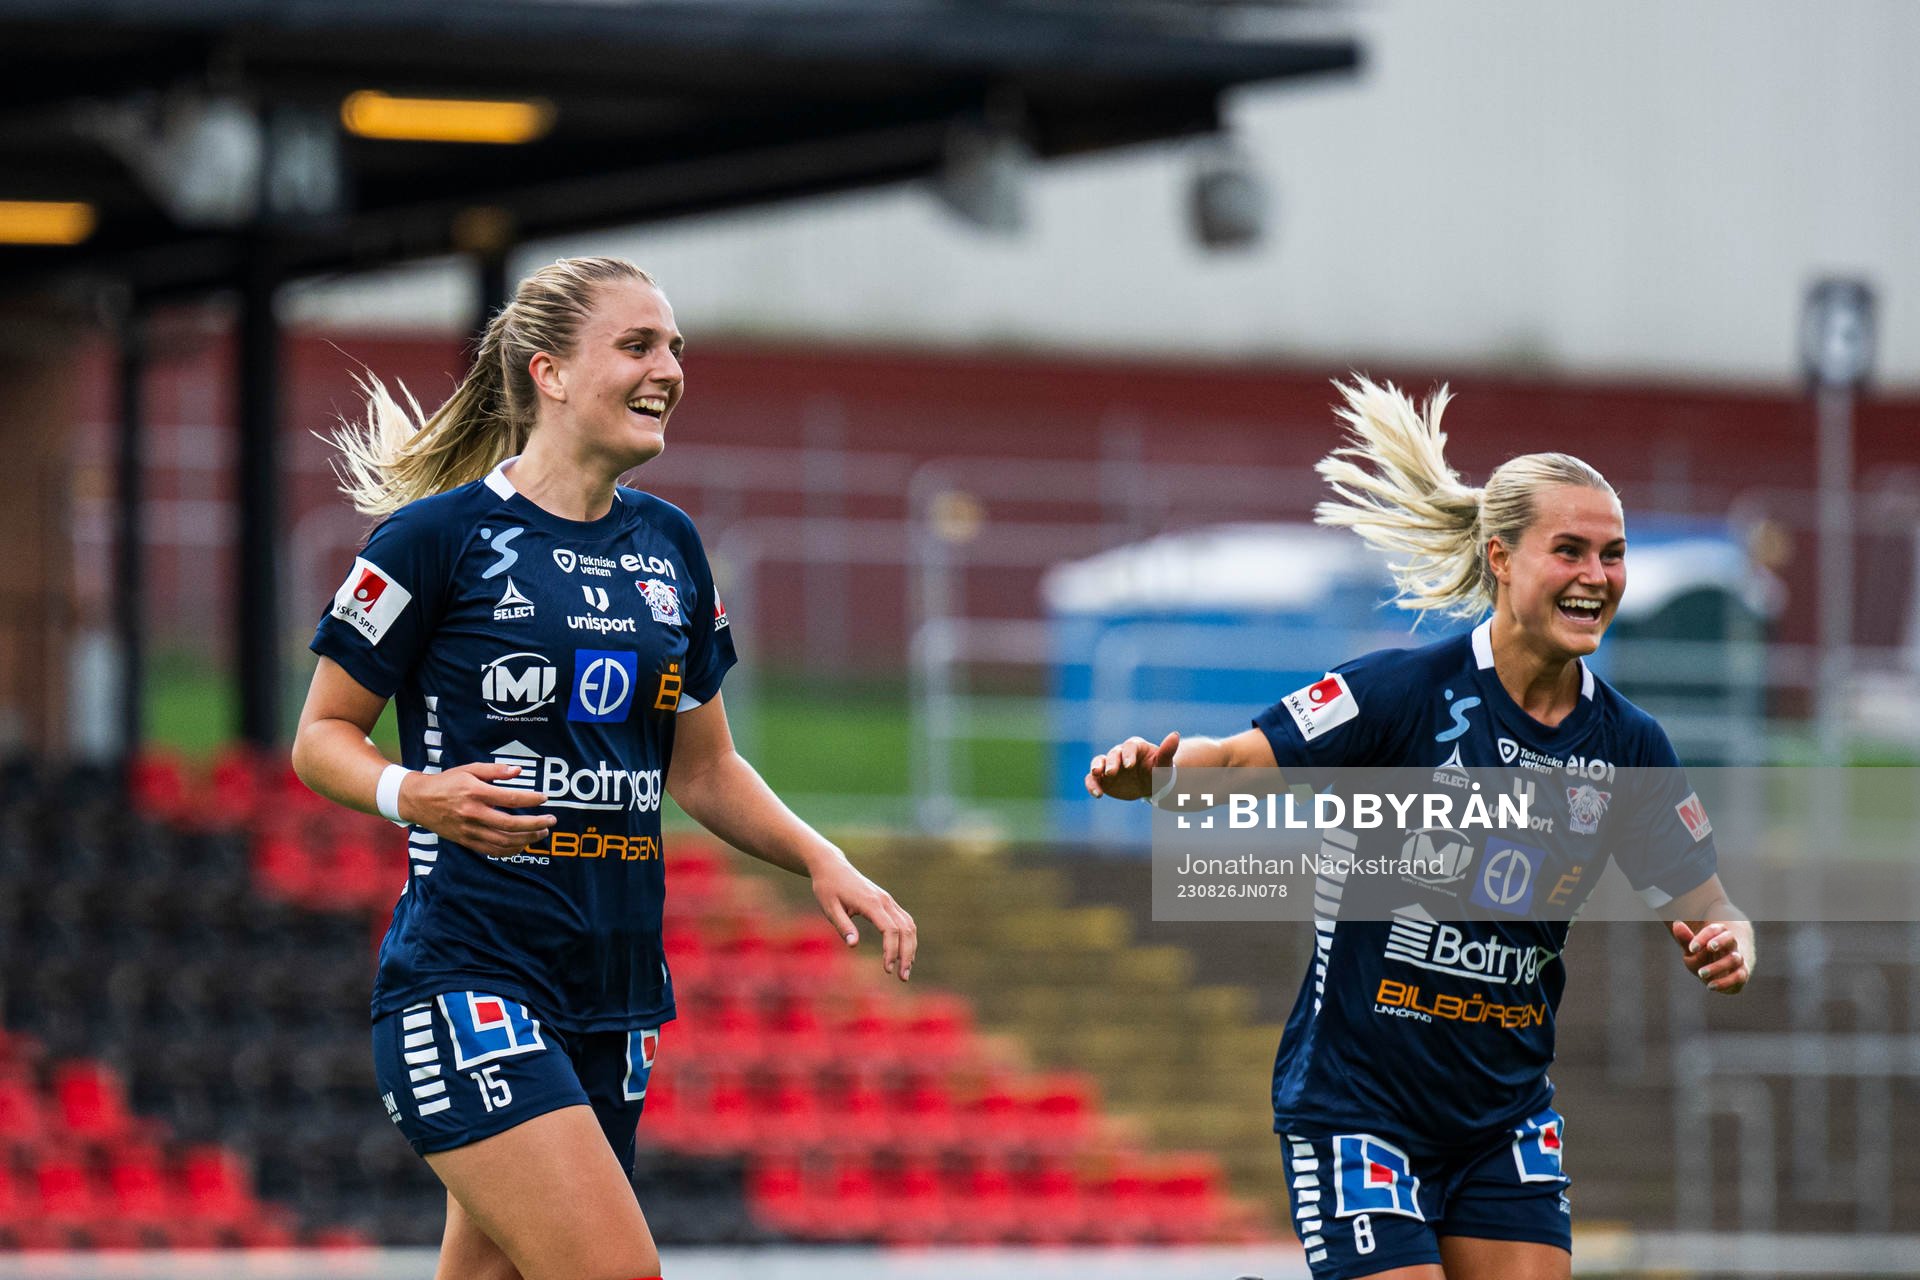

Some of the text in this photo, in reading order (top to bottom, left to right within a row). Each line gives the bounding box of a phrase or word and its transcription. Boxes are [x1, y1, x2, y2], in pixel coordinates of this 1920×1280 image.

[578, 554, 617, 569] Tekniska
[580, 565, 612, 577] verken
[493, 605, 535, 621] SELECT
[566, 612, 637, 635] unisport
[358, 616, 379, 638] SPEL
[1519, 758, 1553, 775] verken
[1520, 748, 1563, 769] Tekniska
[541, 756, 662, 813] Botrygg
[1432, 771, 1470, 789] SELECT
[524, 826, 660, 862] LBÖRSEN
[1374, 1004, 1432, 1024] LINKÖPING
[1376, 979, 1546, 1028] BILBÖRSEN
[470, 1065, 513, 1112] 15
[1353, 1214, 1376, 1255] 8
